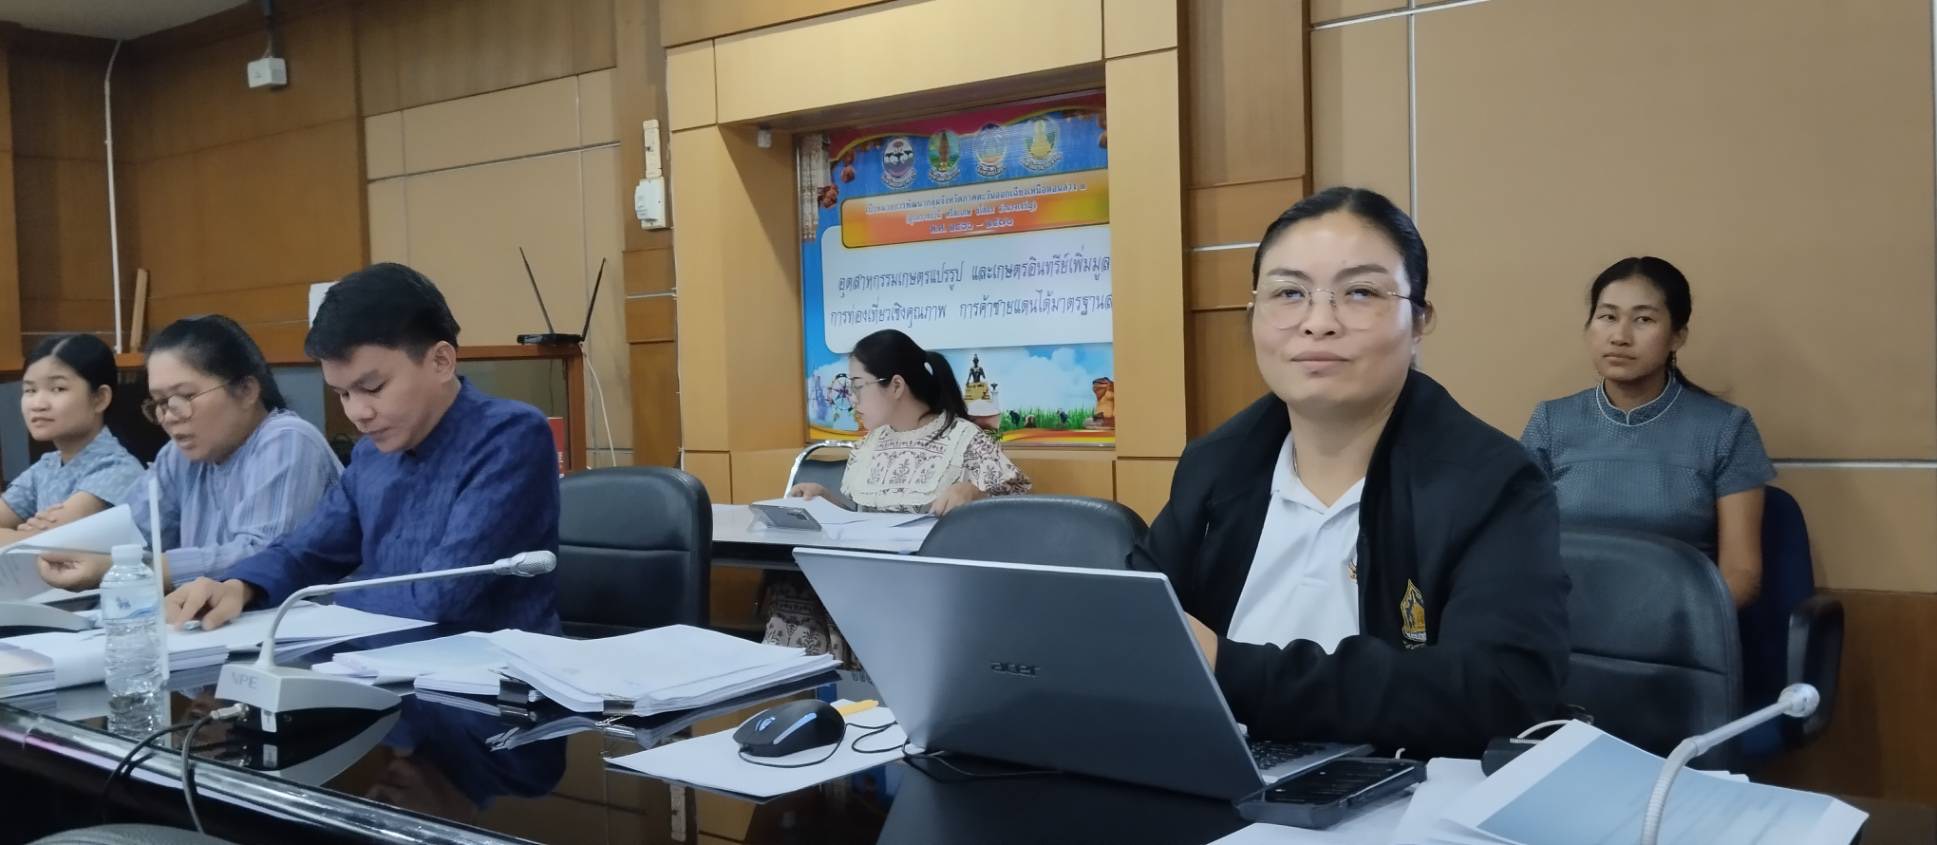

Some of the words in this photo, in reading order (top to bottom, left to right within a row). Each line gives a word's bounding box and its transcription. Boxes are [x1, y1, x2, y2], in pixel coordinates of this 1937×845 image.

[838, 261, 964, 298] อุตสาหกรรมเกษตรแปรรูป
[830, 297, 946, 328] การท่องเที่ยวเชิงคุณภาพ
[991, 662, 1039, 677] acer
